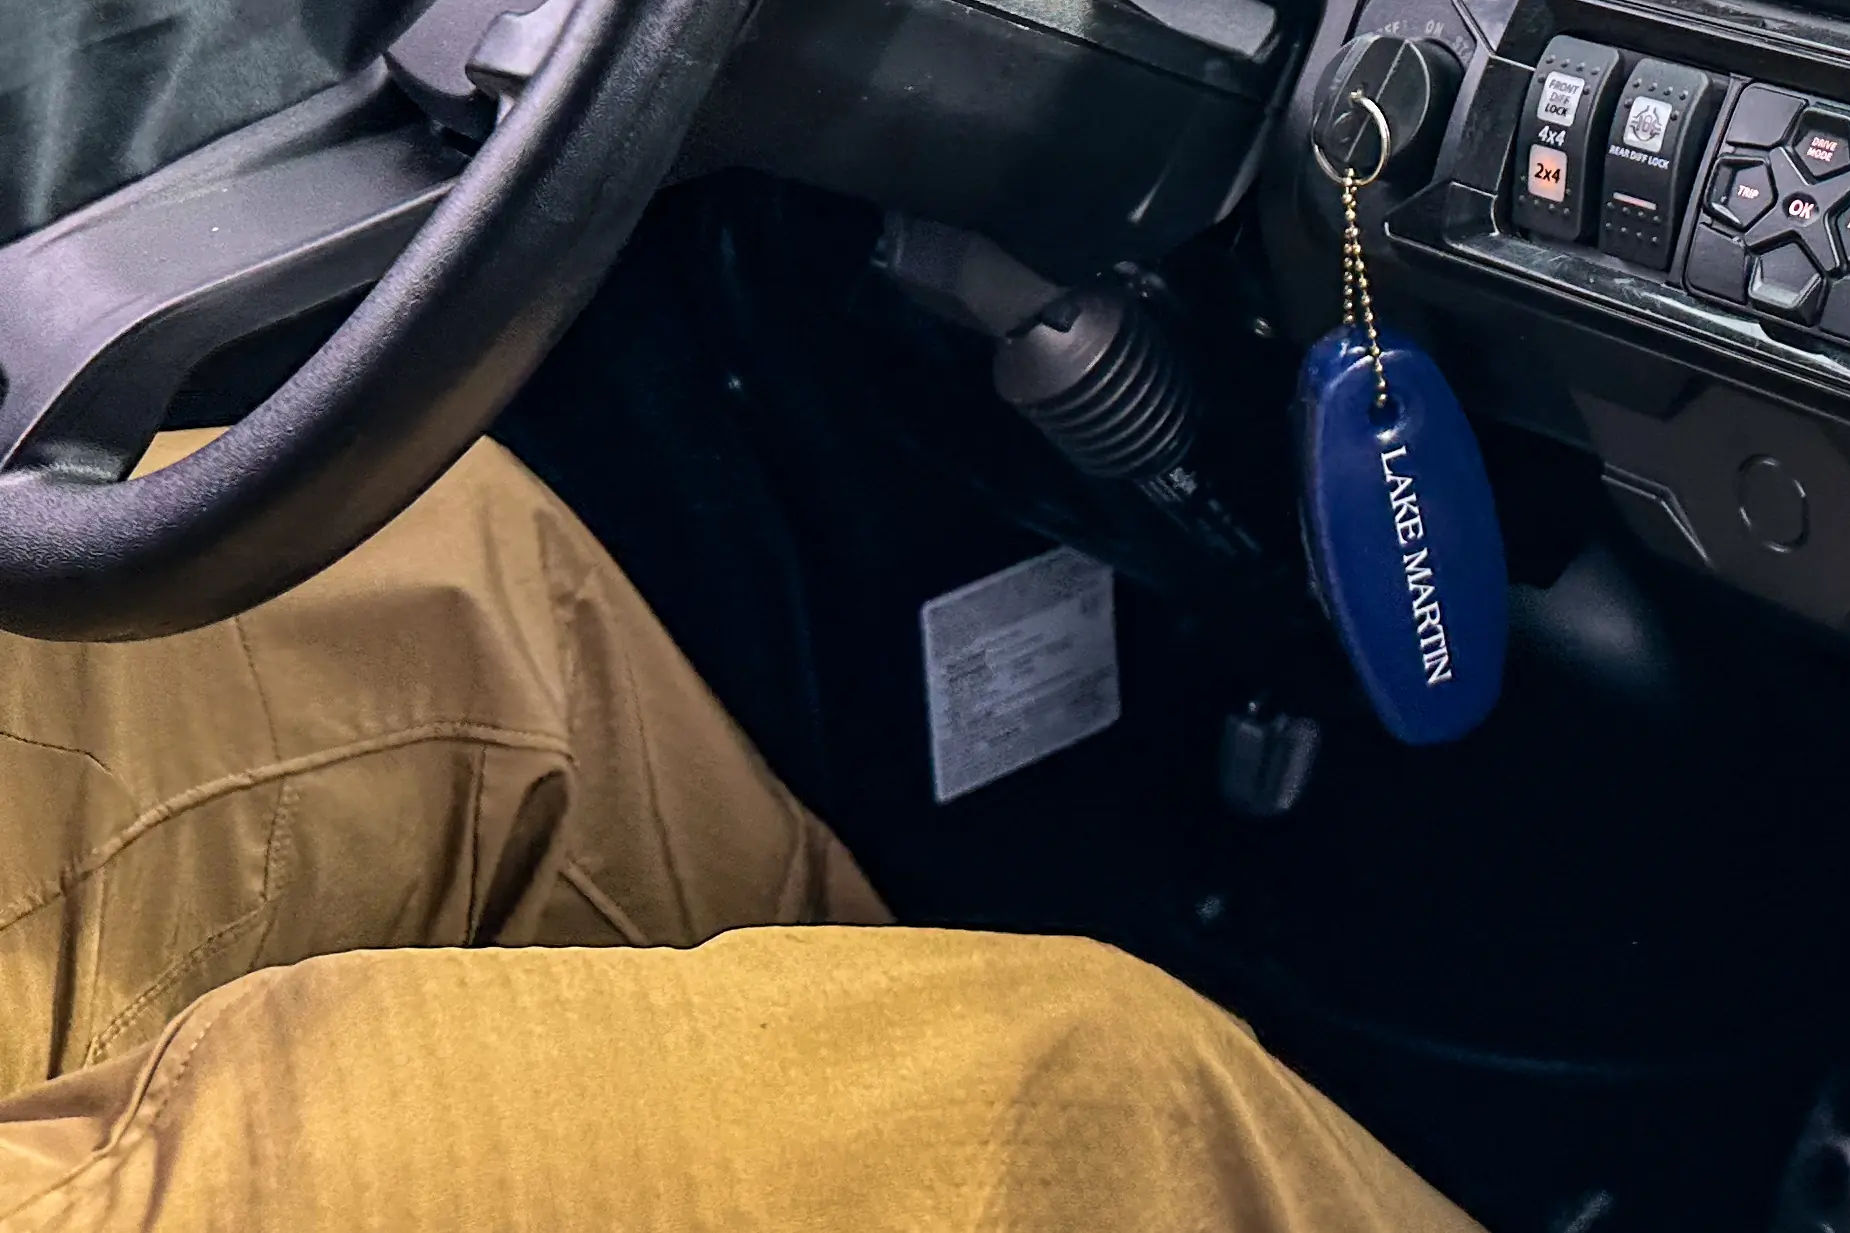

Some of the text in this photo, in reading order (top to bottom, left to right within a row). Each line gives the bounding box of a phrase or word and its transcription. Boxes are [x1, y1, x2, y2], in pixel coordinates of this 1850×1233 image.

[1548, 79, 1580, 95] FRONT
[1544, 103, 1570, 117] LOCK
[1538, 125, 1567, 147] 4x4
[1811, 135, 1839, 151] DRIVE
[1609, 144, 1630, 158] REAR
[1648, 156, 1670, 170] LOCK
[1806, 147, 1833, 163] MODE
[1534, 162, 1562, 184] 2x4
[1737, 184, 1760, 200] TRIP
[1788, 199, 1815, 219] OK
[1380, 445, 1453, 687] LAKE MARTIN
